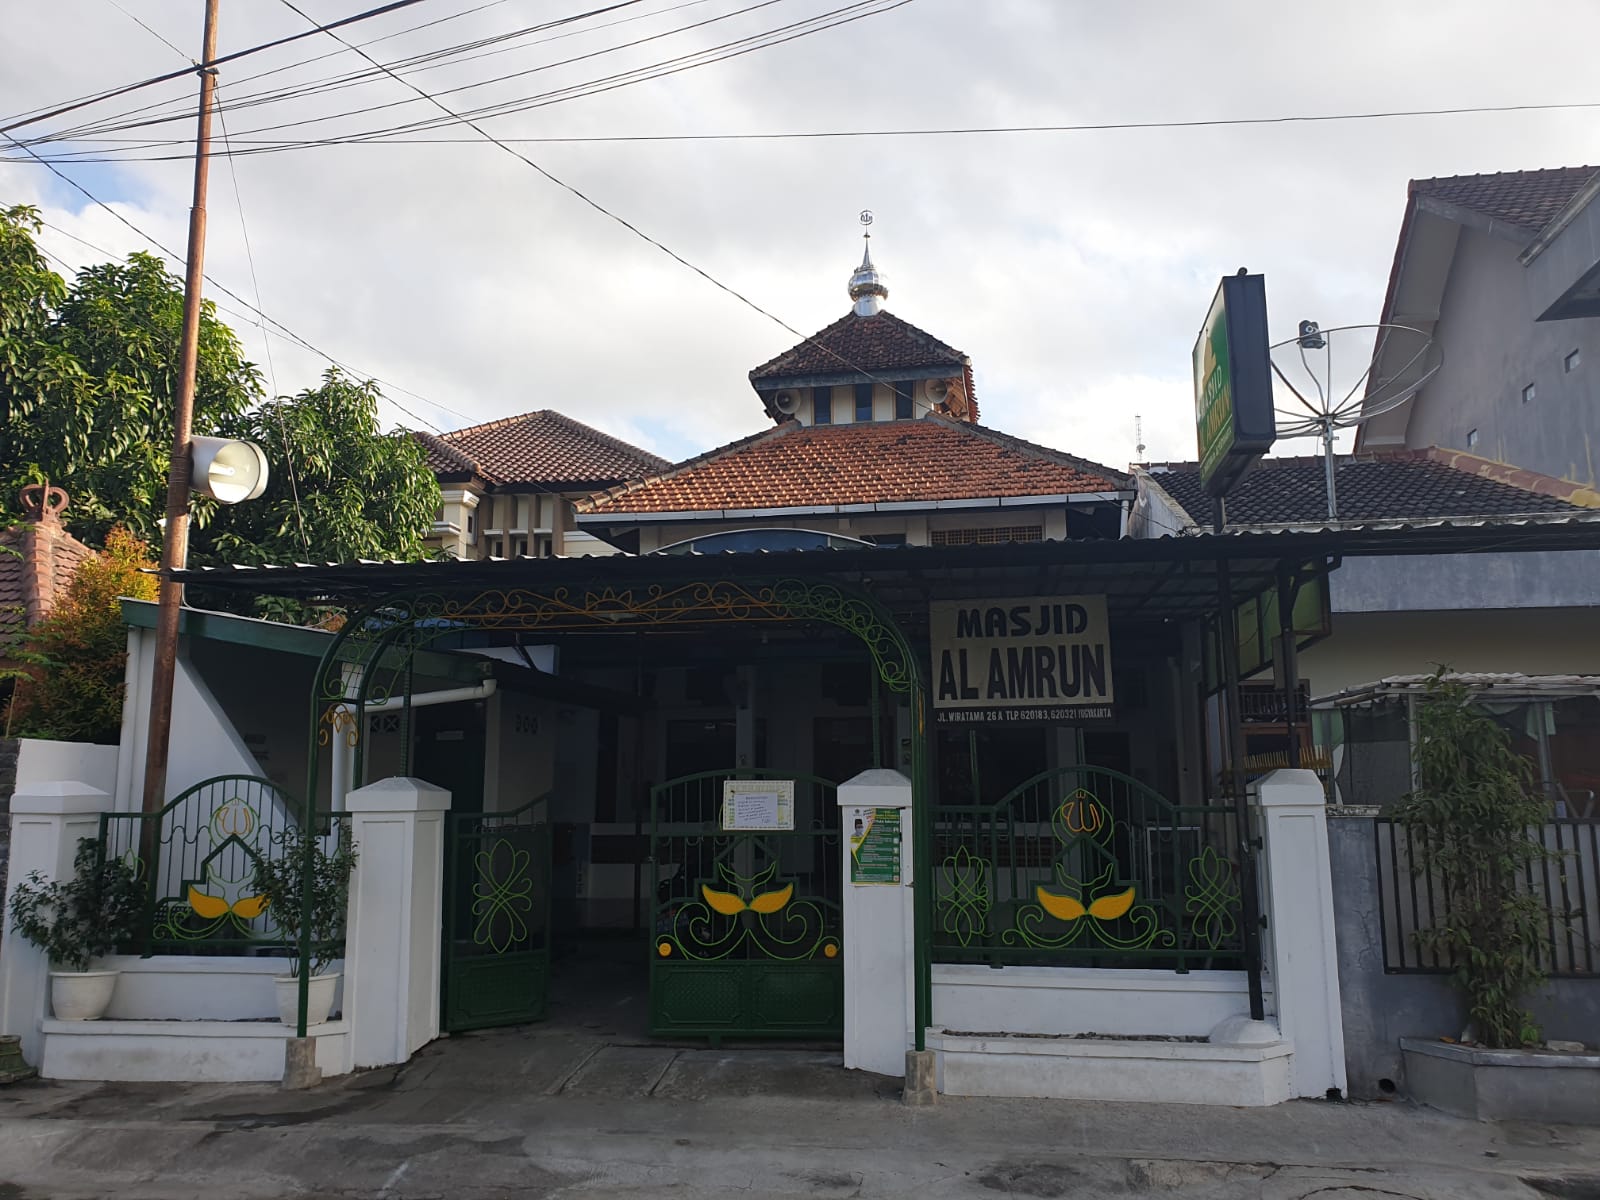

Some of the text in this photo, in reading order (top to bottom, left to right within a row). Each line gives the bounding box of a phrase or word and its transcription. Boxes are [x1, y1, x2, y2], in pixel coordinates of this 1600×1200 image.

[957, 603, 1088, 638] MASJID
[938, 643, 1107, 700] AL AMRUN
[948, 711, 985, 722] WIRATAMA
